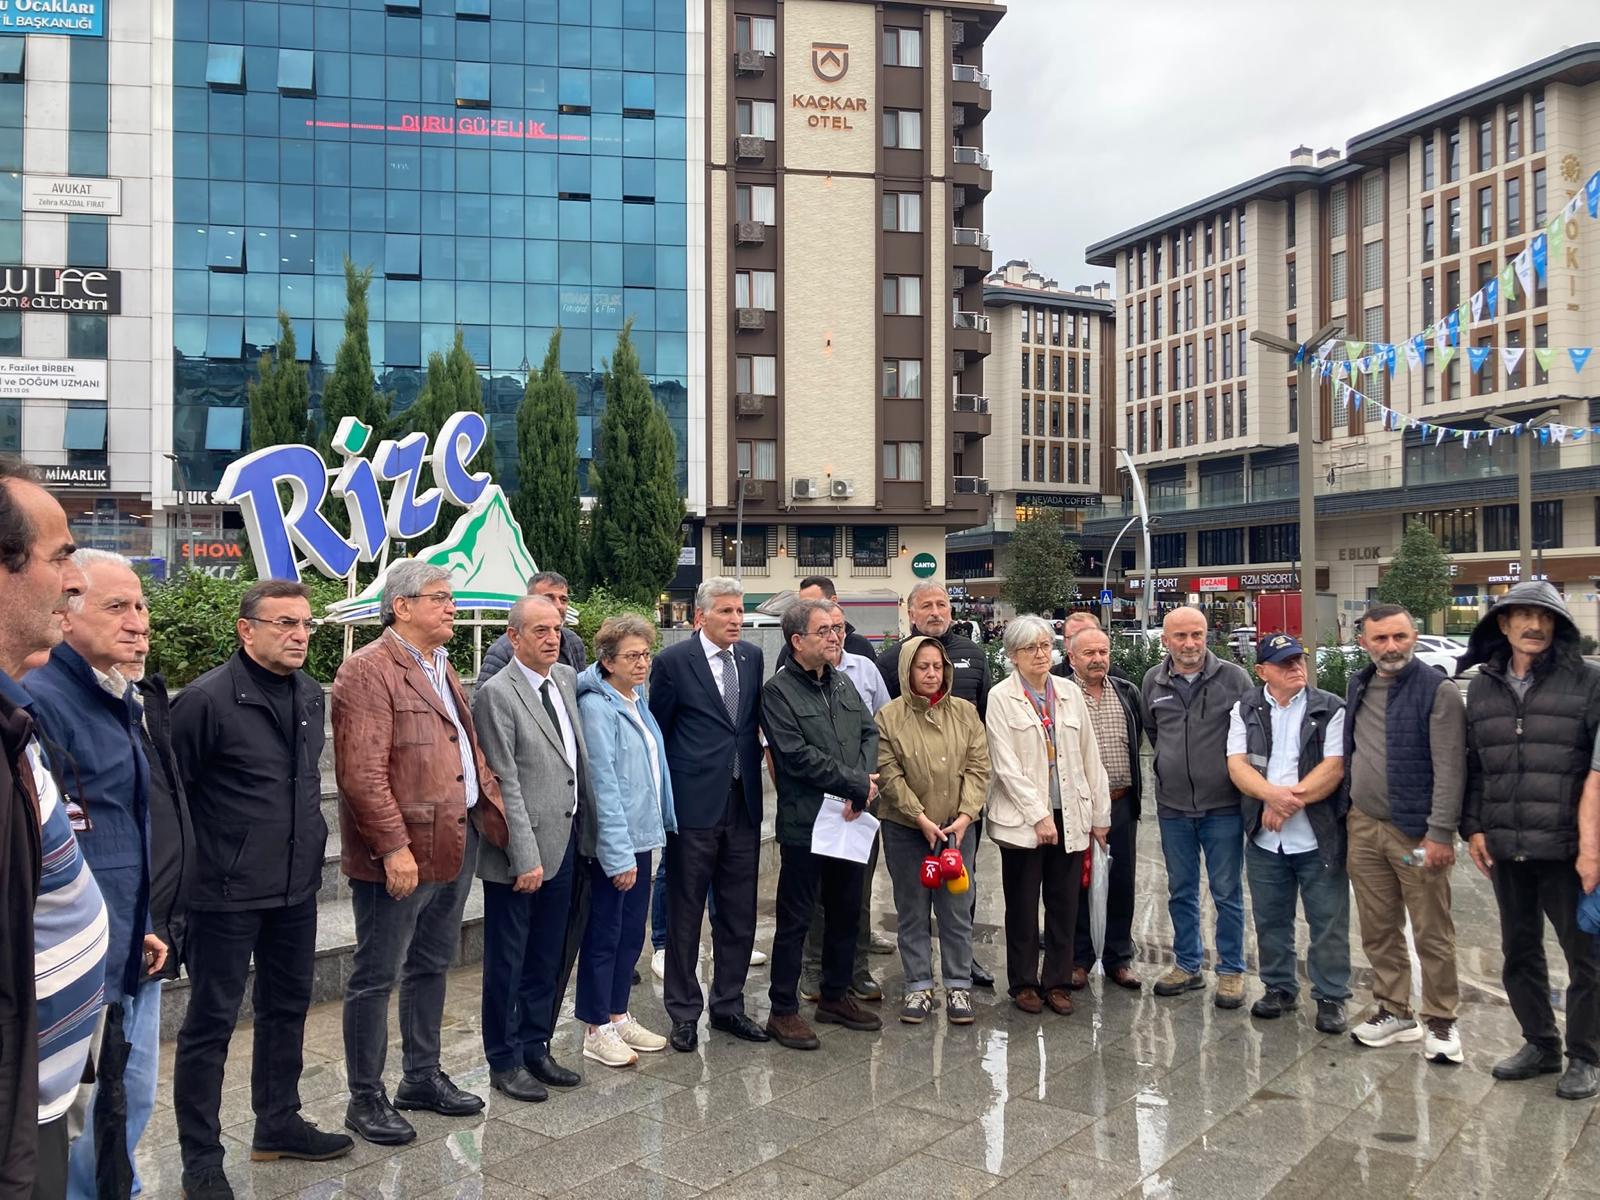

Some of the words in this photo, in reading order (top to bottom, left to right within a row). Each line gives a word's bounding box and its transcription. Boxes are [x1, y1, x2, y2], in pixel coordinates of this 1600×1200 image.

[16, 16, 92, 29] BAŞKANLIĞI
[793, 94, 867, 111] KAÇKAR
[402, 115, 454, 133] DURU
[808, 115, 853, 129] OTEL
[52, 183, 92, 194] AVUKAT
[59, 199, 85, 207] KAZDAL
[86, 200, 105, 208] FIRAT
[9, 363, 39, 372] Fazilet
[42, 363, 74, 373] BİRBEN
[19, 377, 58, 387] DOĞUM
[61, 379, 99, 388] UZMANI
[46, 467, 106, 481] MİMARLIK
[216, 411, 491, 582] Rize
[1065, 497, 1095, 506] COFFEE
[1339, 548, 1346, 561] E
[1349, 546, 1380, 561] BLOK
[1201, 577, 1227, 586] ECZANE
[1241, 574, 1261, 585] RZM
